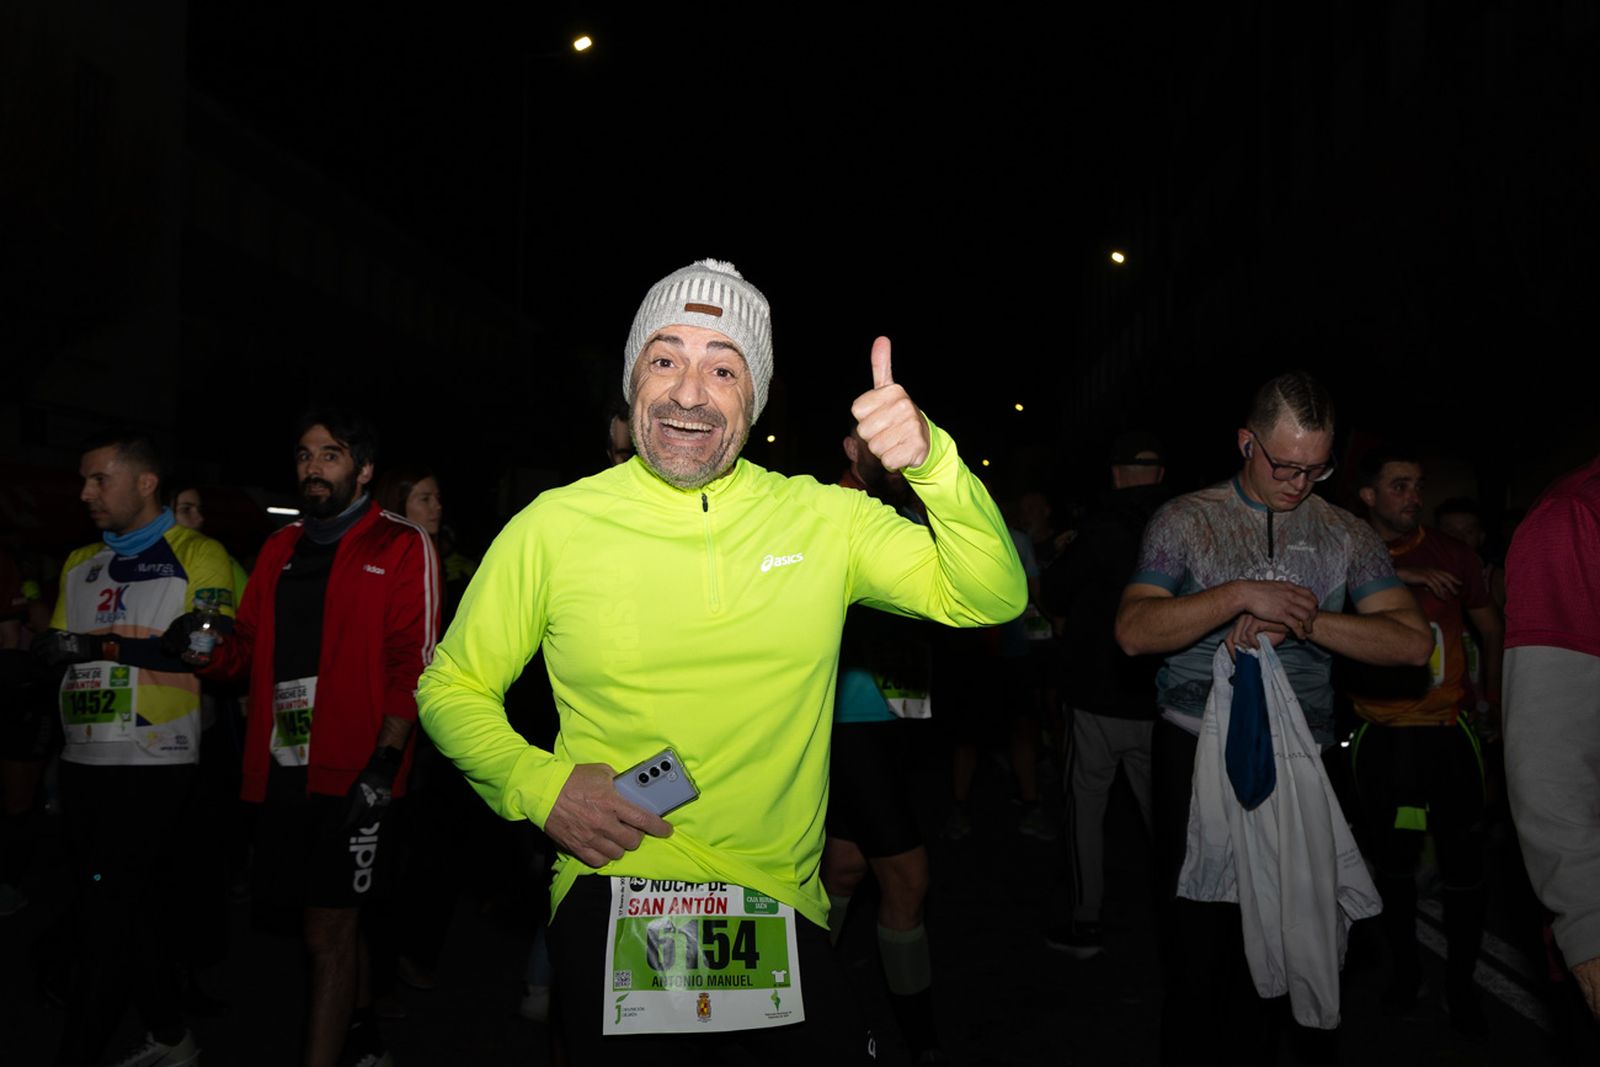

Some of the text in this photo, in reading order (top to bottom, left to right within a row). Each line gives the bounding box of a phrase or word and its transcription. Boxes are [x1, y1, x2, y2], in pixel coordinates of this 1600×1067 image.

[771, 553, 804, 568] asics
[70, 690, 115, 715] 1452
[628, 892, 728, 915] SAN ANTÓN
[647, 919, 760, 971] 6154
[652, 975, 754, 988] ANTONIO MANUEL
